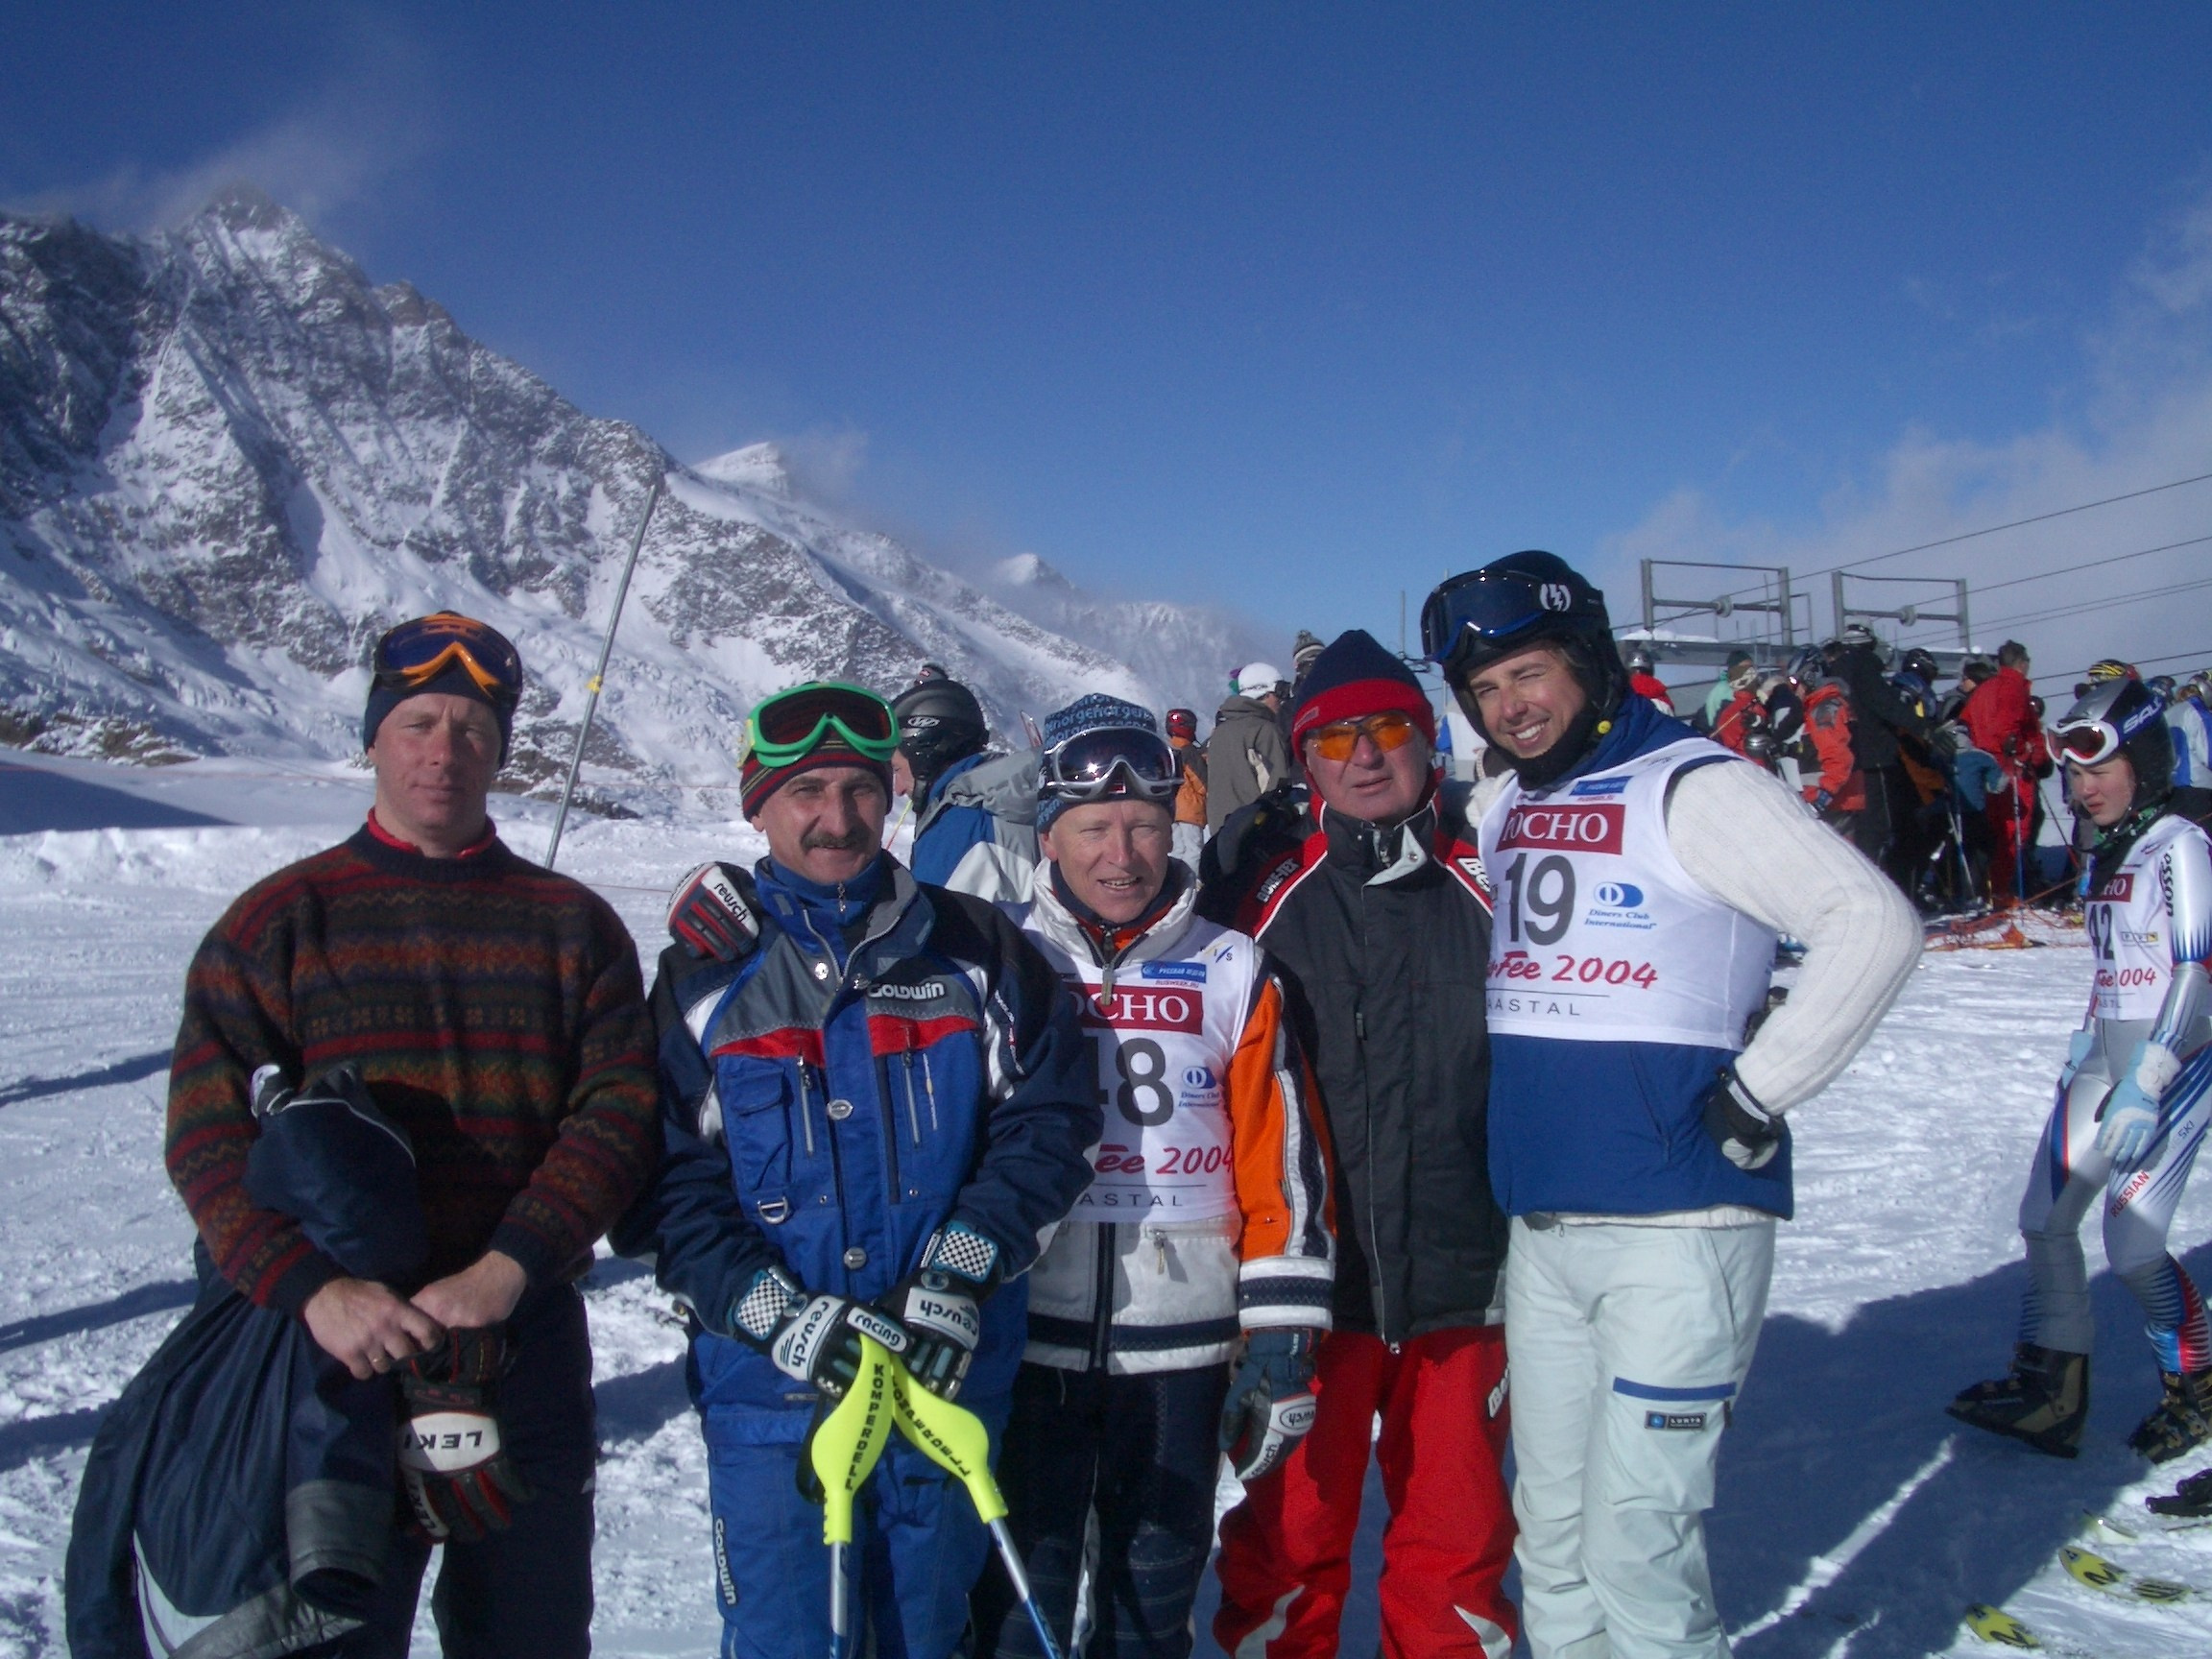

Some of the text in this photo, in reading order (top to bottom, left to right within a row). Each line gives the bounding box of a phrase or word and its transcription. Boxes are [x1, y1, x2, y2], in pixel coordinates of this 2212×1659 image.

[712, 879, 749, 924] reusch
[1505, 853, 1576, 946] 19
[1589, 908, 1649, 920] Diners Club
[1584, 918, 1653, 929] International
[1551, 954, 1658, 990] 2004
[2115, 968, 2156, 987] 004
[1156, 1144, 1234, 1175] 2004
[2110, 1169, 2151, 1218] RUSSIAN
[791, 1301, 830, 1369] reusch
[854, 1314, 902, 1347] racing
[920, 1298, 978, 1336] reusch
[403, 1430, 483, 1451] LEKI
[844, 1363, 884, 1491] KOMPERDELL
